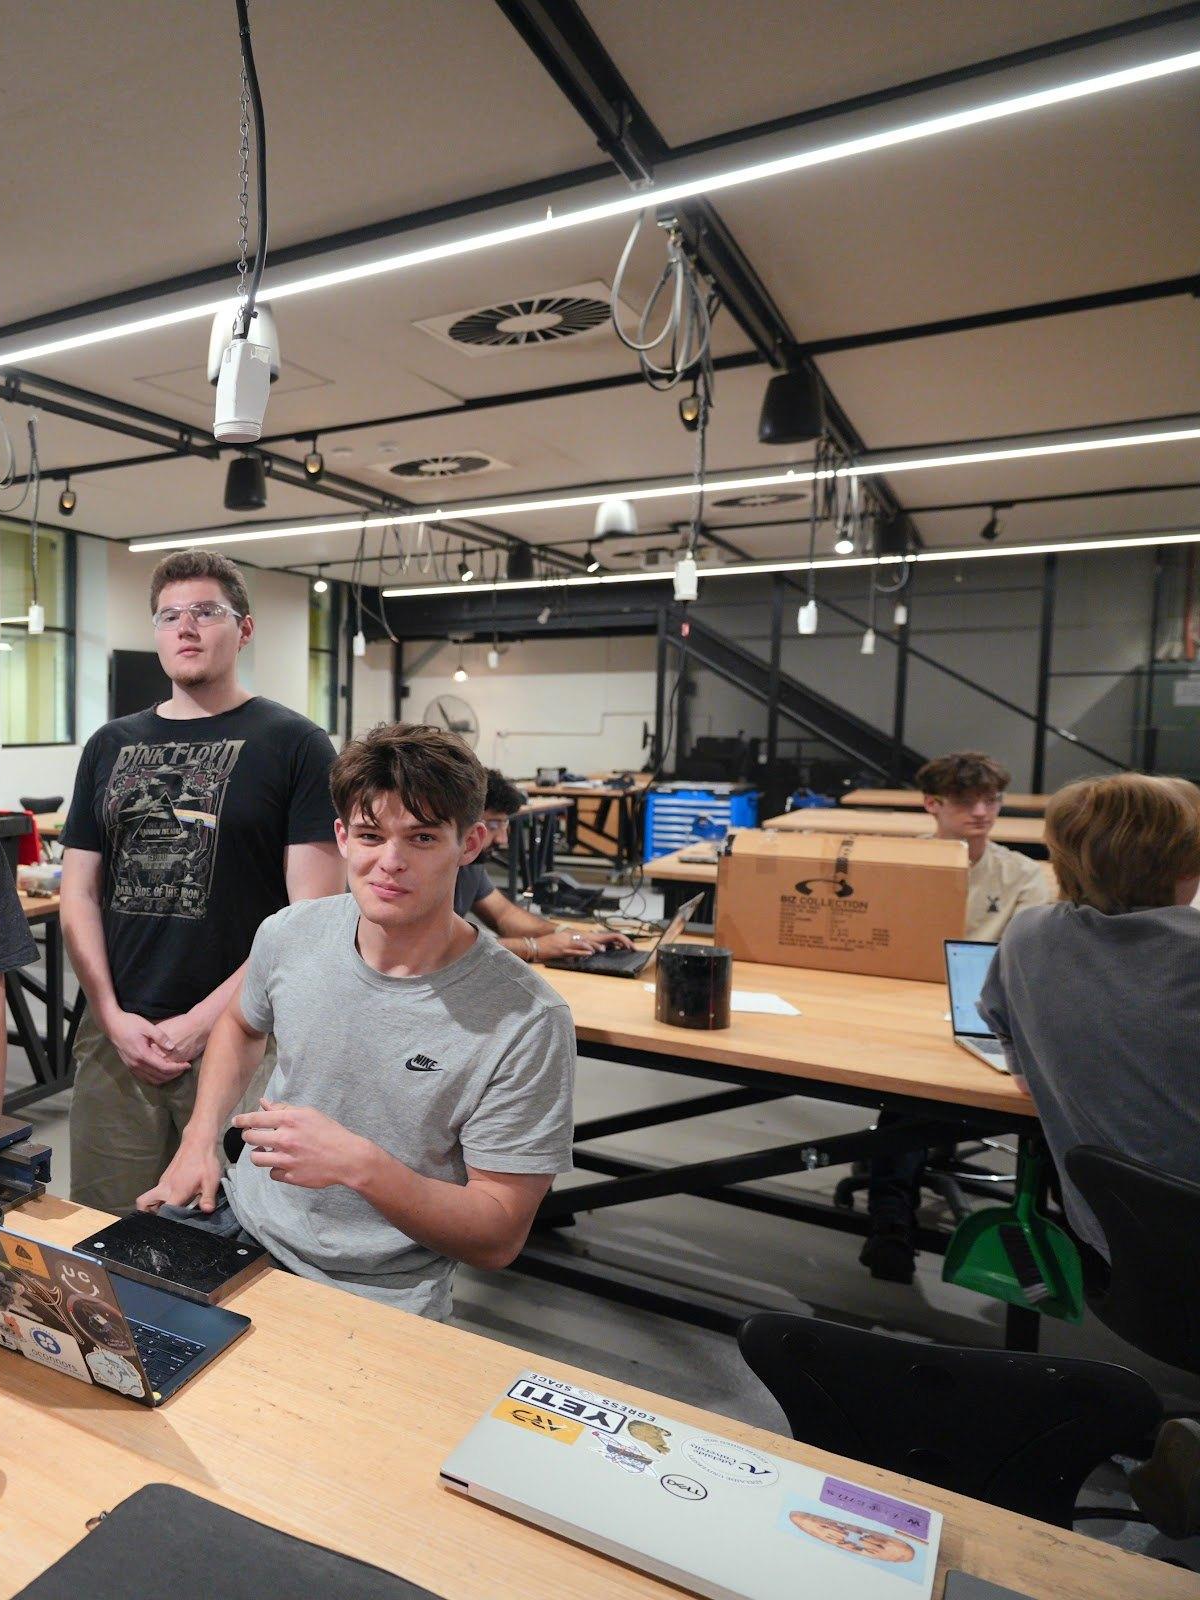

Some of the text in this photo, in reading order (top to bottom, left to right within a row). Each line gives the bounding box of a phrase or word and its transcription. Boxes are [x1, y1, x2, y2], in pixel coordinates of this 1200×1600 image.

[114, 739, 247, 777] PINK FLOYD
[134, 886, 151, 897] SIDE
[153, 886, 163, 897] OF
[165, 885, 179, 897] THE
[781, 895, 796, 904] BIZ
[800, 897, 869, 910] COLLECTION
[413, 1054, 438, 1069] NIKE
[516, 1384, 617, 1429] YETI
[528, 1373, 656, 1422] EGRESS SPACE
[665, 1478, 703, 1496] DELL
